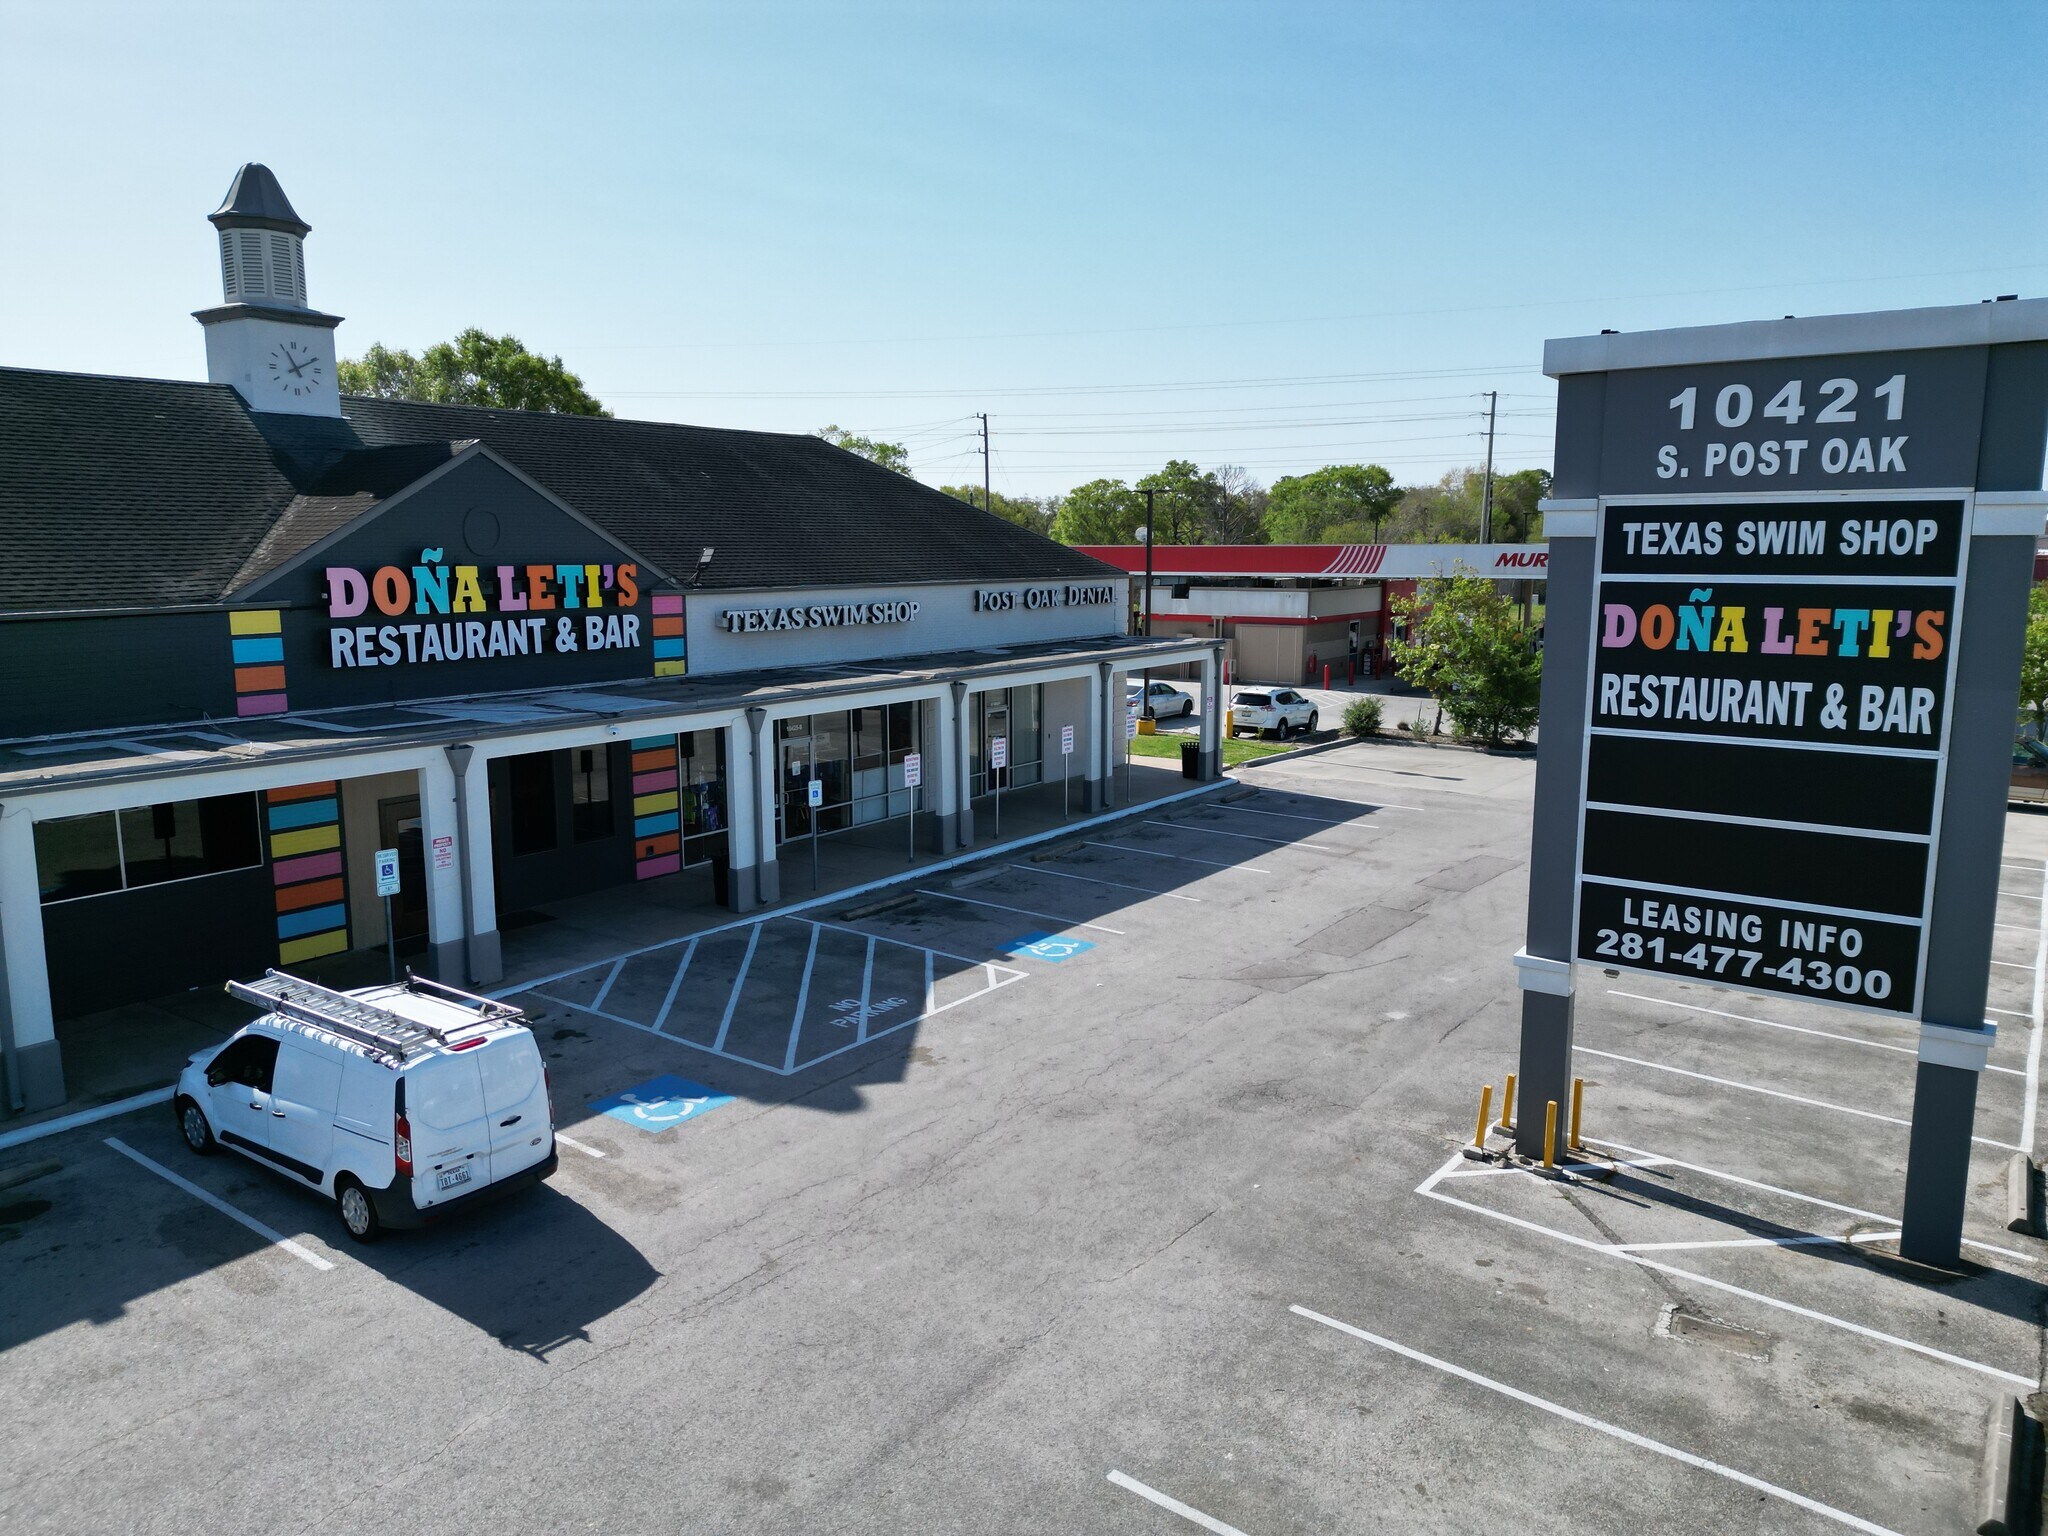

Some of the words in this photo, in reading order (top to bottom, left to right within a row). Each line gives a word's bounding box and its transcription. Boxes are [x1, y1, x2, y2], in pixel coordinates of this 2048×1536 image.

[1669, 374, 1906, 430] 10421
[1656, 444, 1689, 479] S.
[1704, 439, 1809, 477] POST
[1821, 436, 1910, 474] OAK
[1622, 521, 1723, 555] TEXAS
[1736, 520, 1827, 555] SWIM
[1839, 519, 1938, 556] SHOP
[326, 547, 487, 618] DOÑA
[496, 563, 639, 612] LETI'S
[975, 589, 1018, 612] POST
[1024, 588, 1060, 610] OAK
[1066, 585, 1117, 606] DENTAL
[330, 618, 547, 669] RESTAURANT
[555, 616, 578, 653] &
[585, 614, 641, 650] BAR
[726, 606, 805, 633] TEXAS
[807, 603, 868, 629] SWIM
[871, 601, 921, 625] SHOP
[1602, 588, 1749, 653] DOÑA
[1760, 607, 1945, 660] LETI'S
[1600, 673, 1813, 727] RESTAURANT
[1819, 682, 1848, 730] &
[1858, 685, 1936, 735] BAR
[1623, 897, 1764, 943] LEASING
[1779, 919, 1864, 958] INFO
[1595, 928, 1892, 999] 281-477-4300
